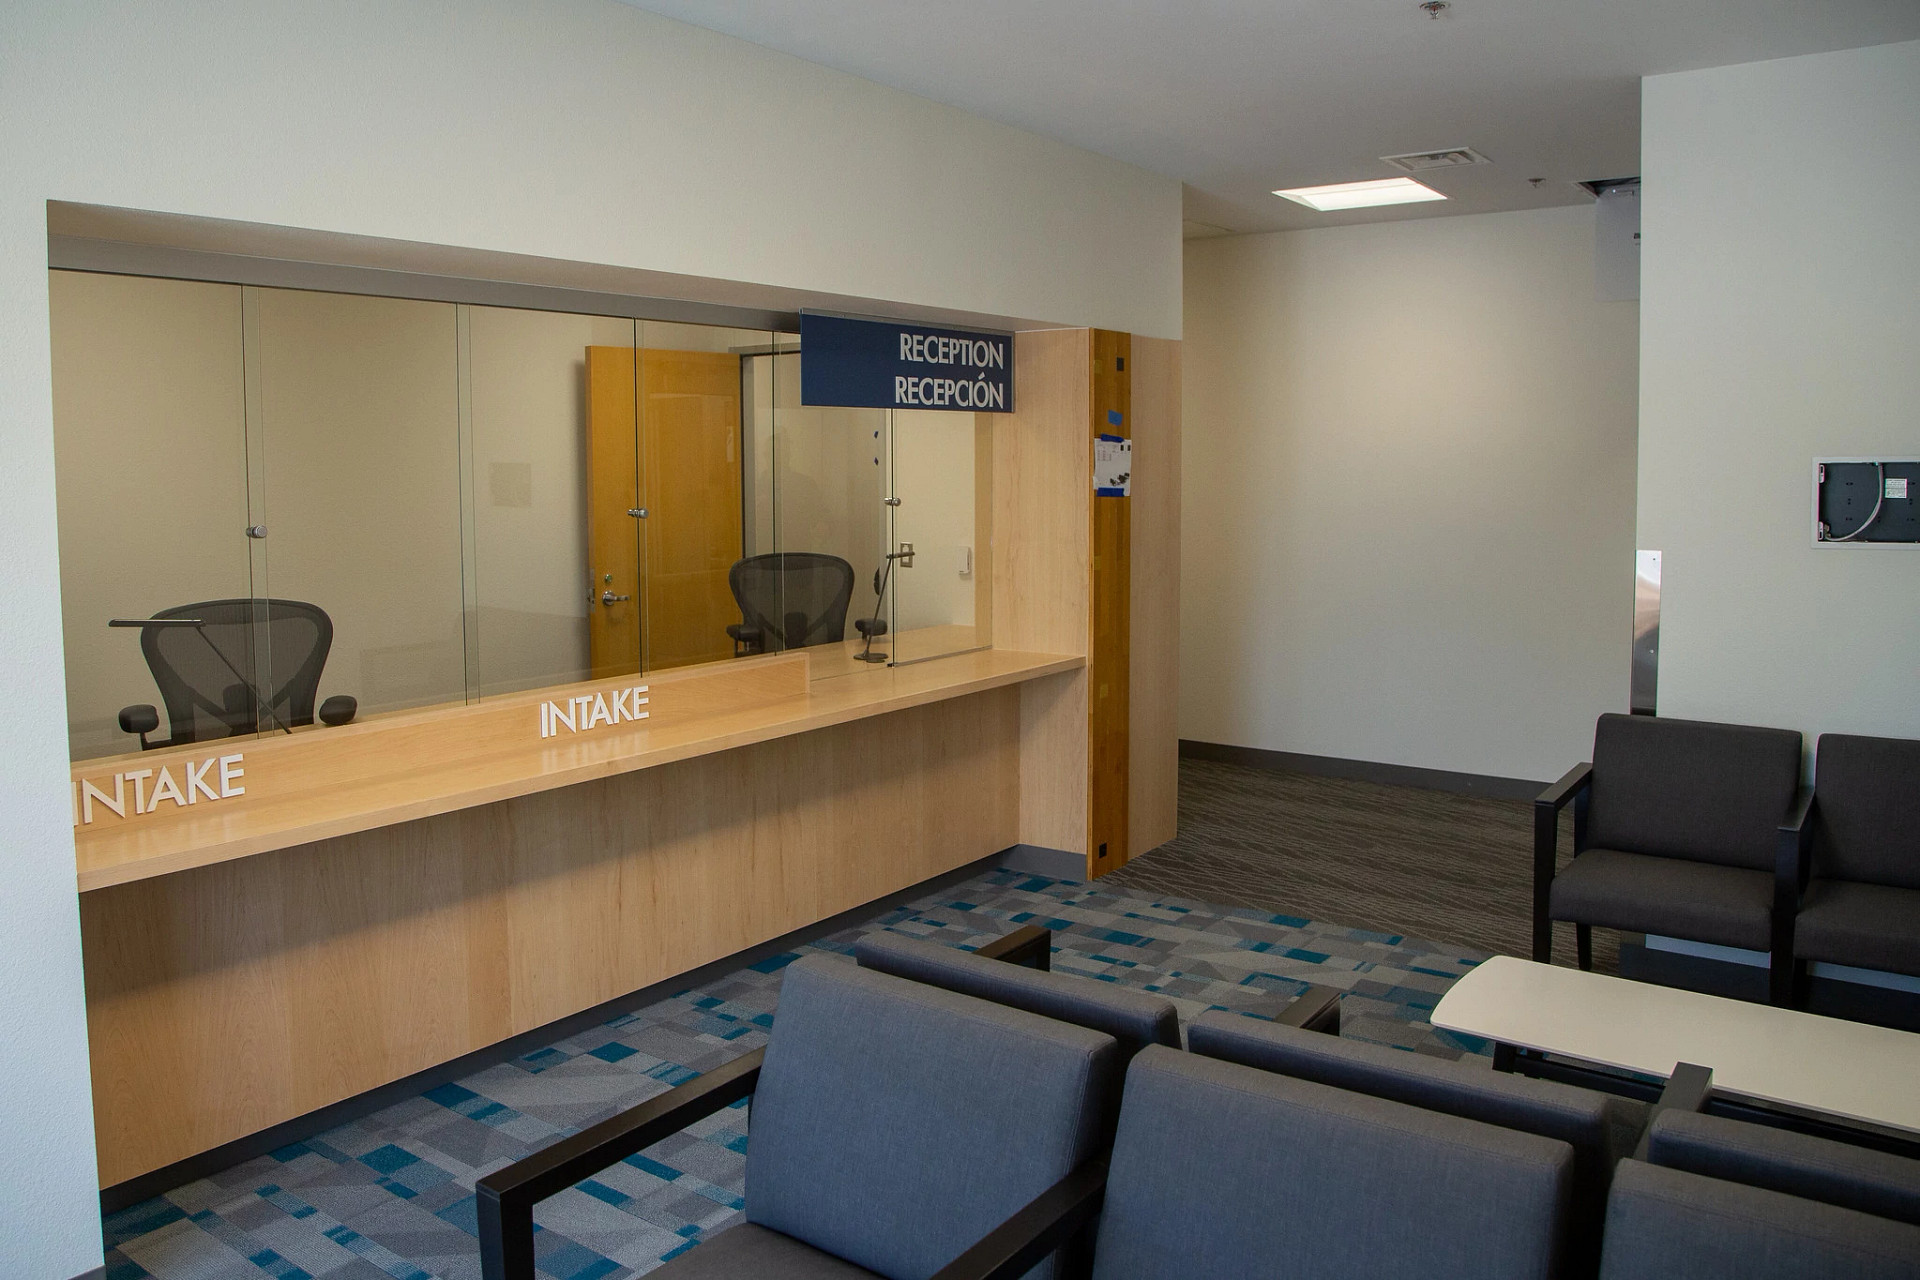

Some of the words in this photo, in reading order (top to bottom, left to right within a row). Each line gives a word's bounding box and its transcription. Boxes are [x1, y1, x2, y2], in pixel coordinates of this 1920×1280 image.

[900, 333, 1004, 370] RECEPTION
[895, 371, 1004, 409] RECEPCIÓN
[541, 685, 650, 738] INTAKE
[72, 753, 246, 826] INTAKE
